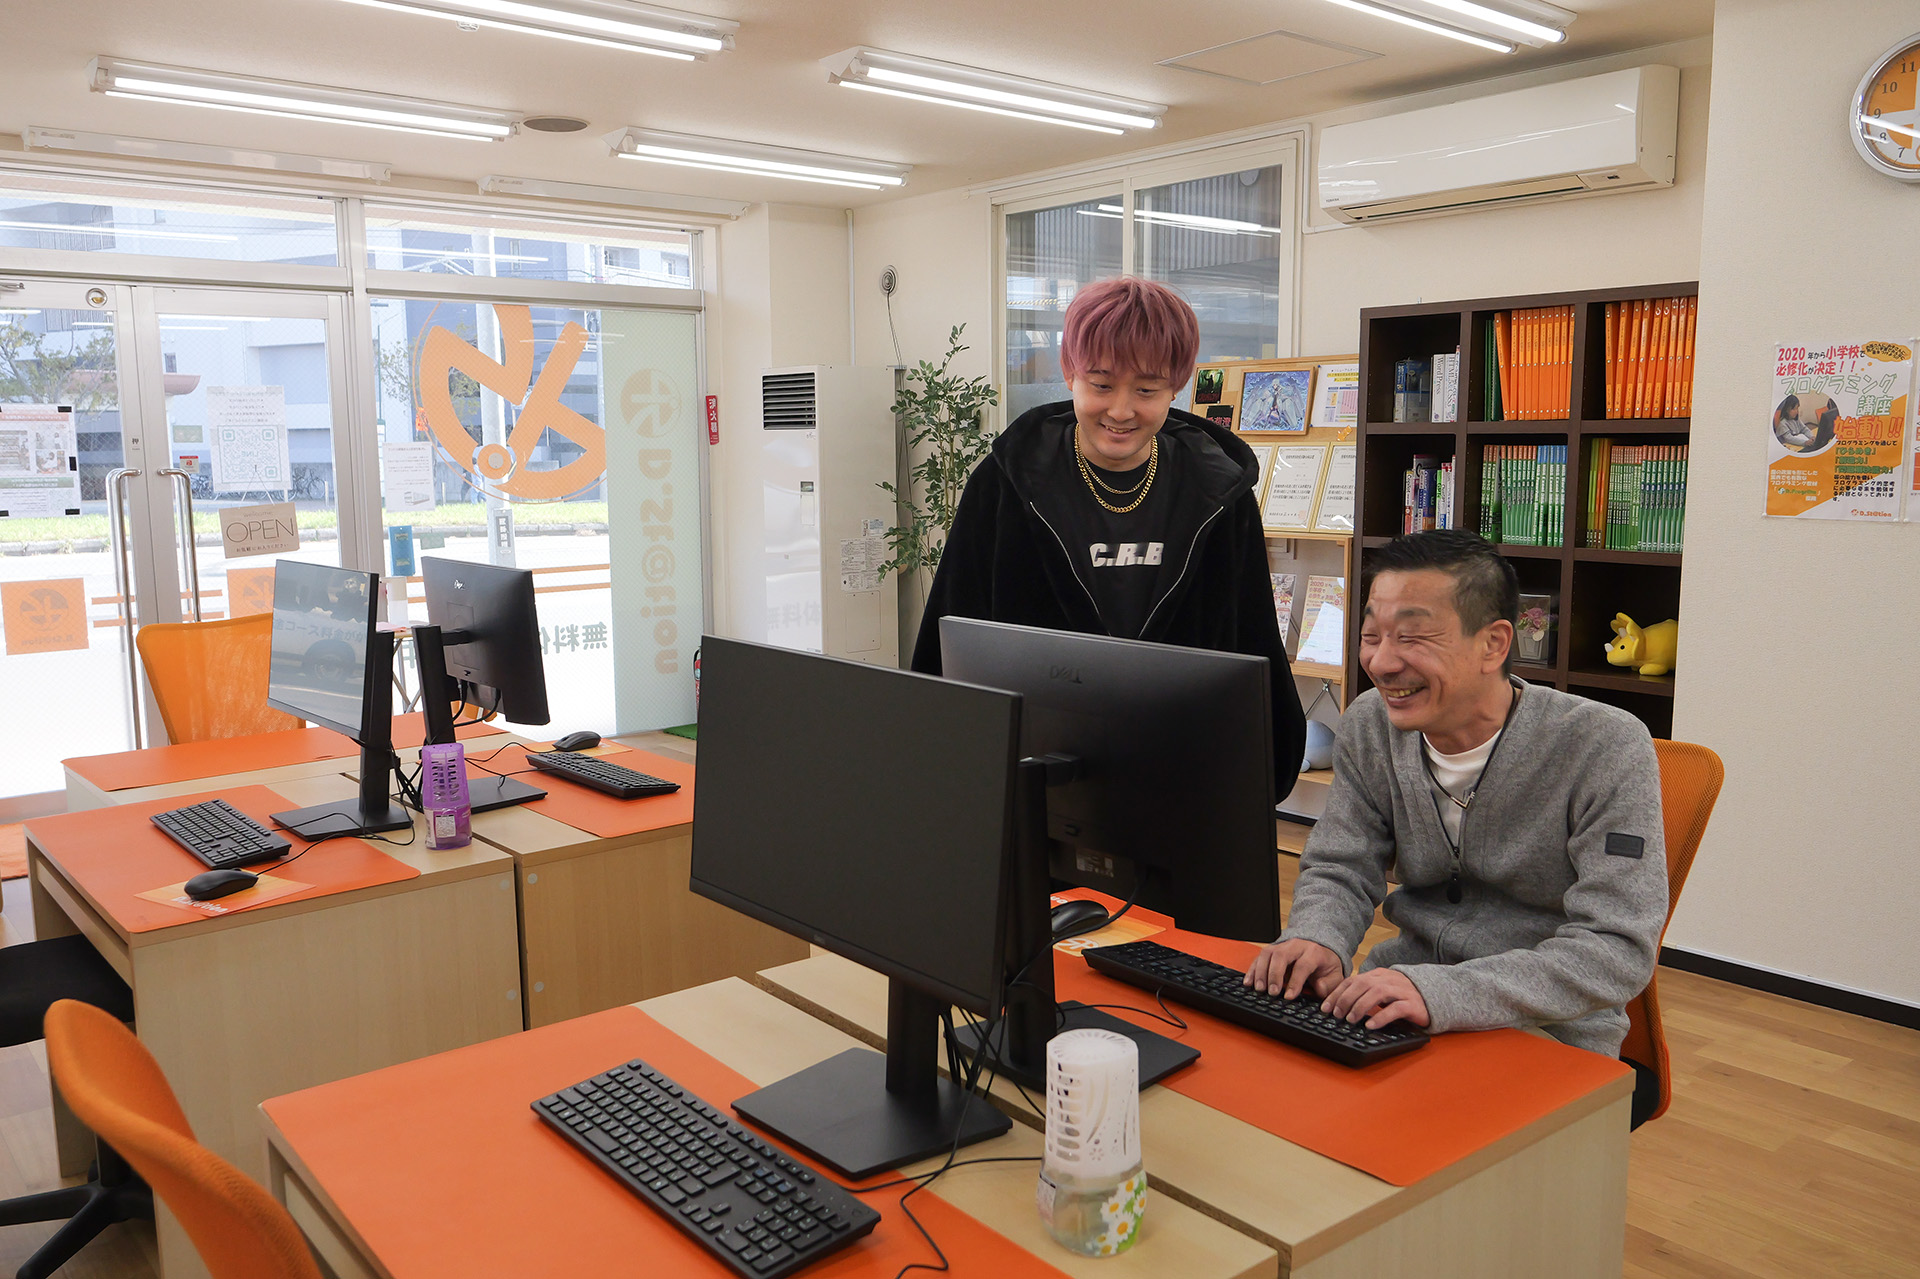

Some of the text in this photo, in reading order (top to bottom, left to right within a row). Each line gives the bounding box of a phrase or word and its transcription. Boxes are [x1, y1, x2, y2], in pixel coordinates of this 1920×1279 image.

[1900, 61, 1915, 74] 11
[1881, 82, 1898, 94] 10
[1873, 108, 1881, 119] 9
[1897, 147, 1906, 158] 7
[1781, 373, 1898, 395] プログラミング
[708, 397, 718, 433] 消火器
[1856, 395, 1894, 416] 講座
[226, 517, 294, 543] OPEN
[1089, 541, 1165, 568] C.R.B
[1050, 664, 1082, 685] DELL
